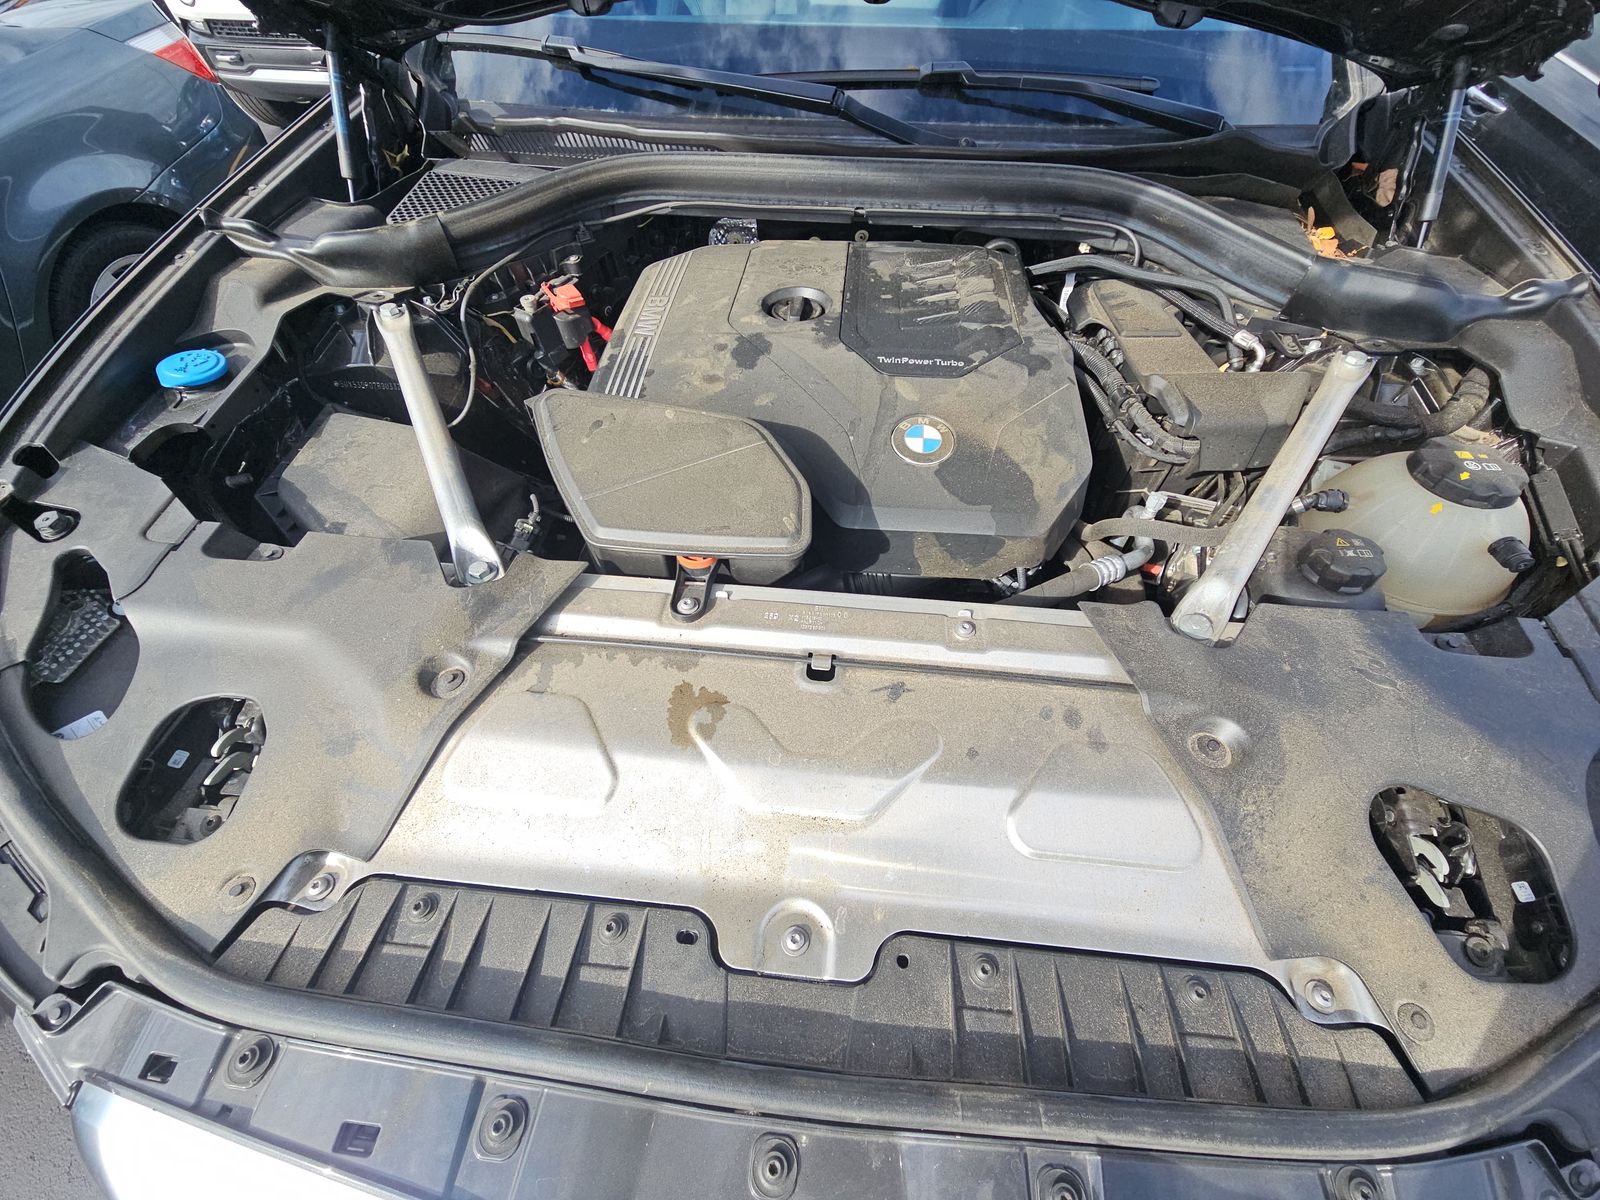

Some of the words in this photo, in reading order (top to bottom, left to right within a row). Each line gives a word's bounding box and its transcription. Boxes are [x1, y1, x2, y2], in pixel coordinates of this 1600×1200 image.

[634, 295, 671, 336] BMW
[934, 358, 965, 367] Turbo
[900, 418, 949, 433] BMW
